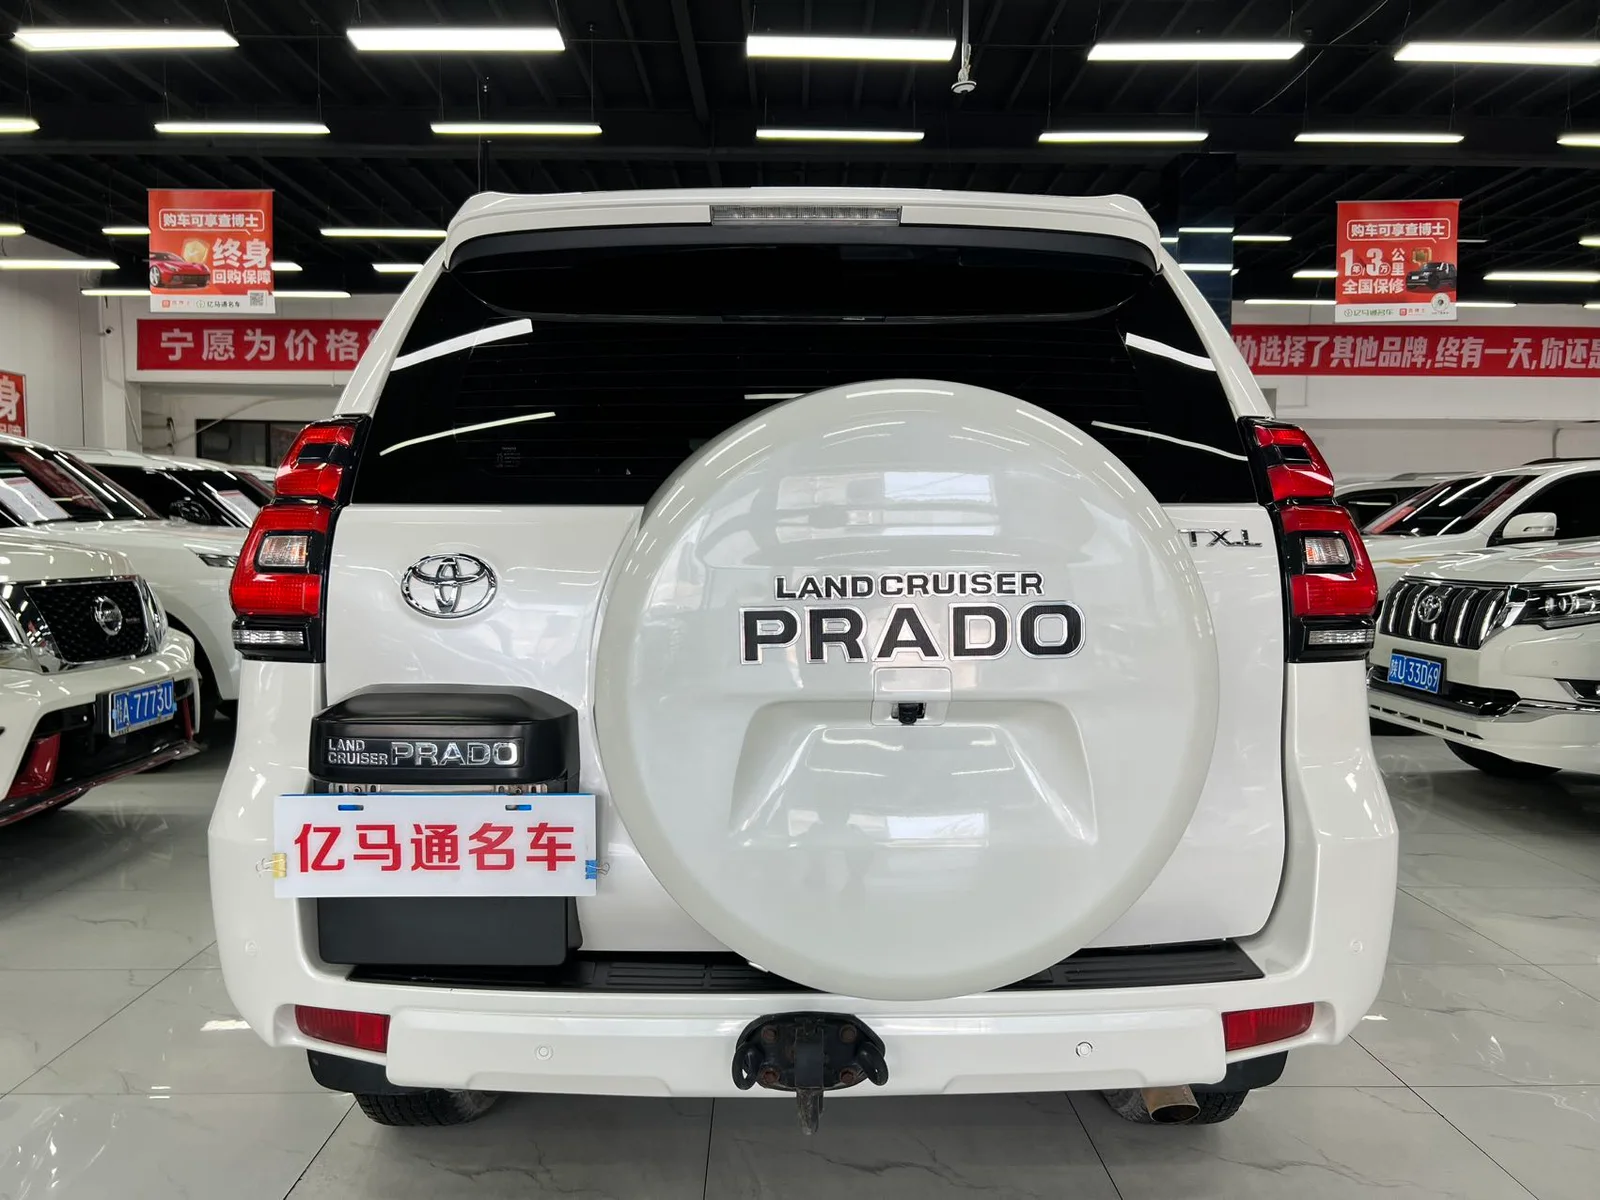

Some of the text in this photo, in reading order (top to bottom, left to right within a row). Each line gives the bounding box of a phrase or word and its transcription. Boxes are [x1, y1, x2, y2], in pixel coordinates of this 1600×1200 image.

[1351, 222, 1445, 237] 购车可享查博士
[212, 238, 270, 268] 终身
[212, 269, 271, 284] 回购保障
[1342, 279, 1404, 294] 全国保修
[160, 328, 378, 362] 宁愿为价格
[774, 571, 1046, 600] LAND CRUISER
[739, 600, 1086, 665] PRADO
[328, 739, 366, 752] LAND
[391, 741, 518, 766] PRADO
[328, 752, 388, 765] CRUISER
[294, 822, 576, 872] 亿马通名车
